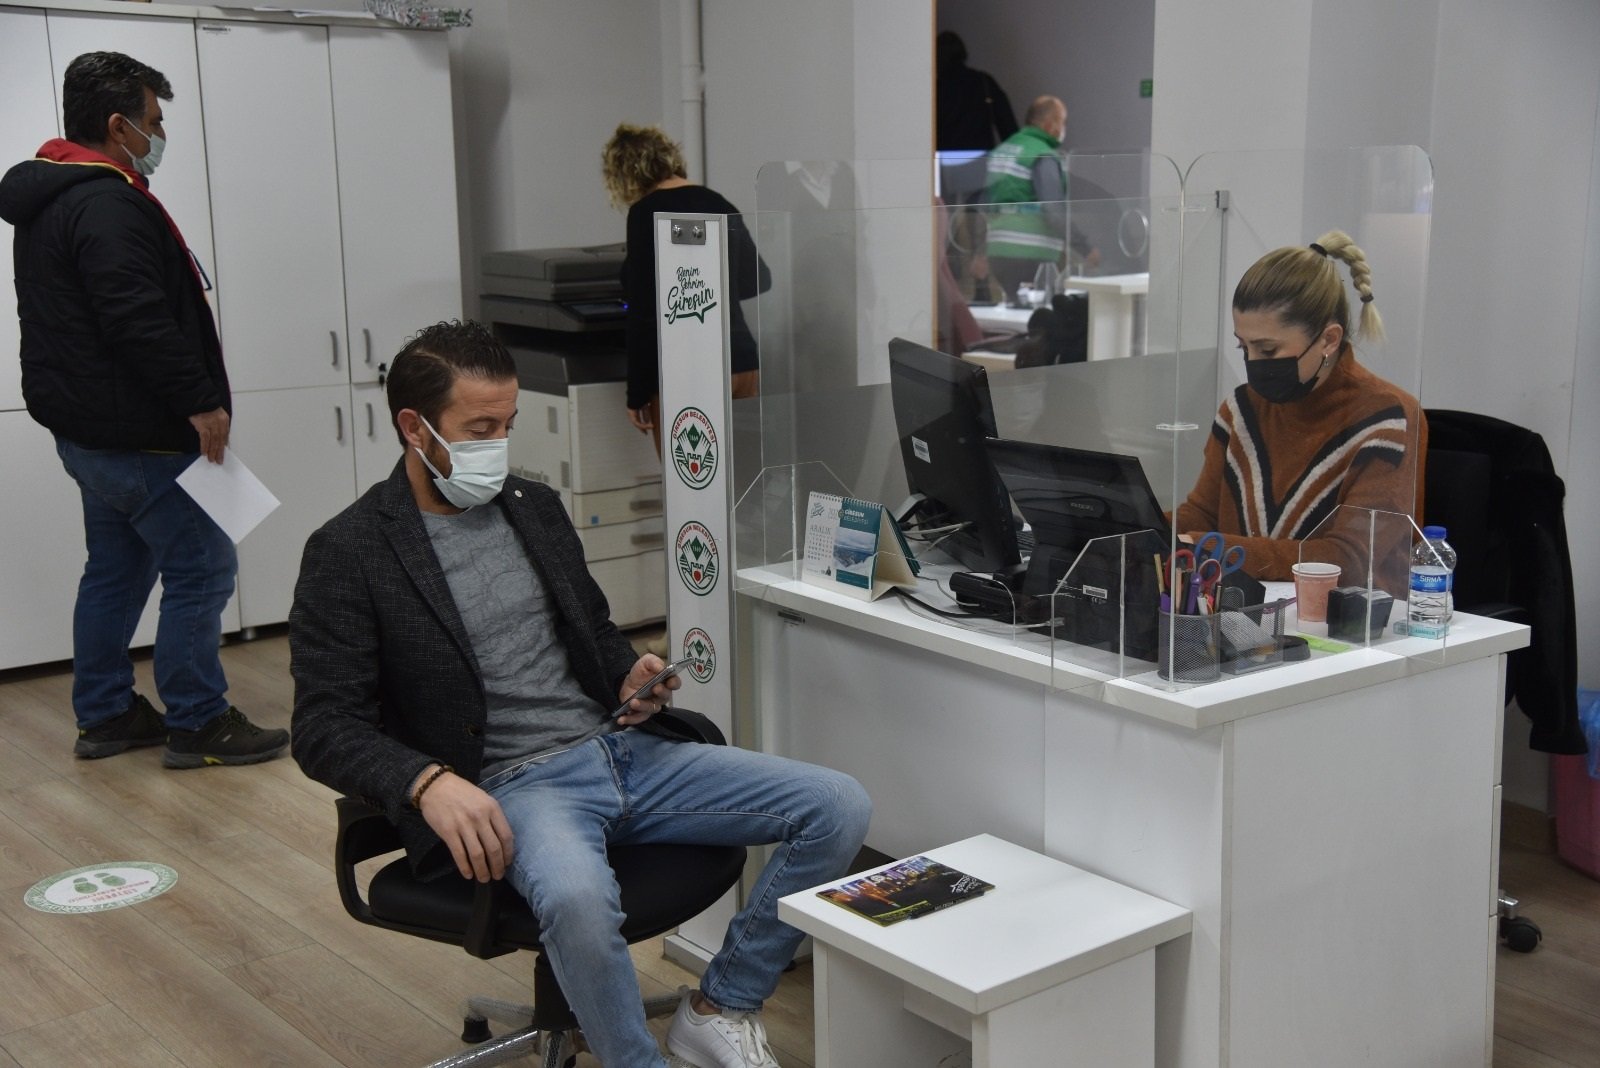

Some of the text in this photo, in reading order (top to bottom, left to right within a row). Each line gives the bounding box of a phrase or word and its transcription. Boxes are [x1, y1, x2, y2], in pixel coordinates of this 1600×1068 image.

[676, 266, 700, 282] Benim
[667, 286, 714, 325] Giresun
[1419, 575, 1442, 583] SIRMA
